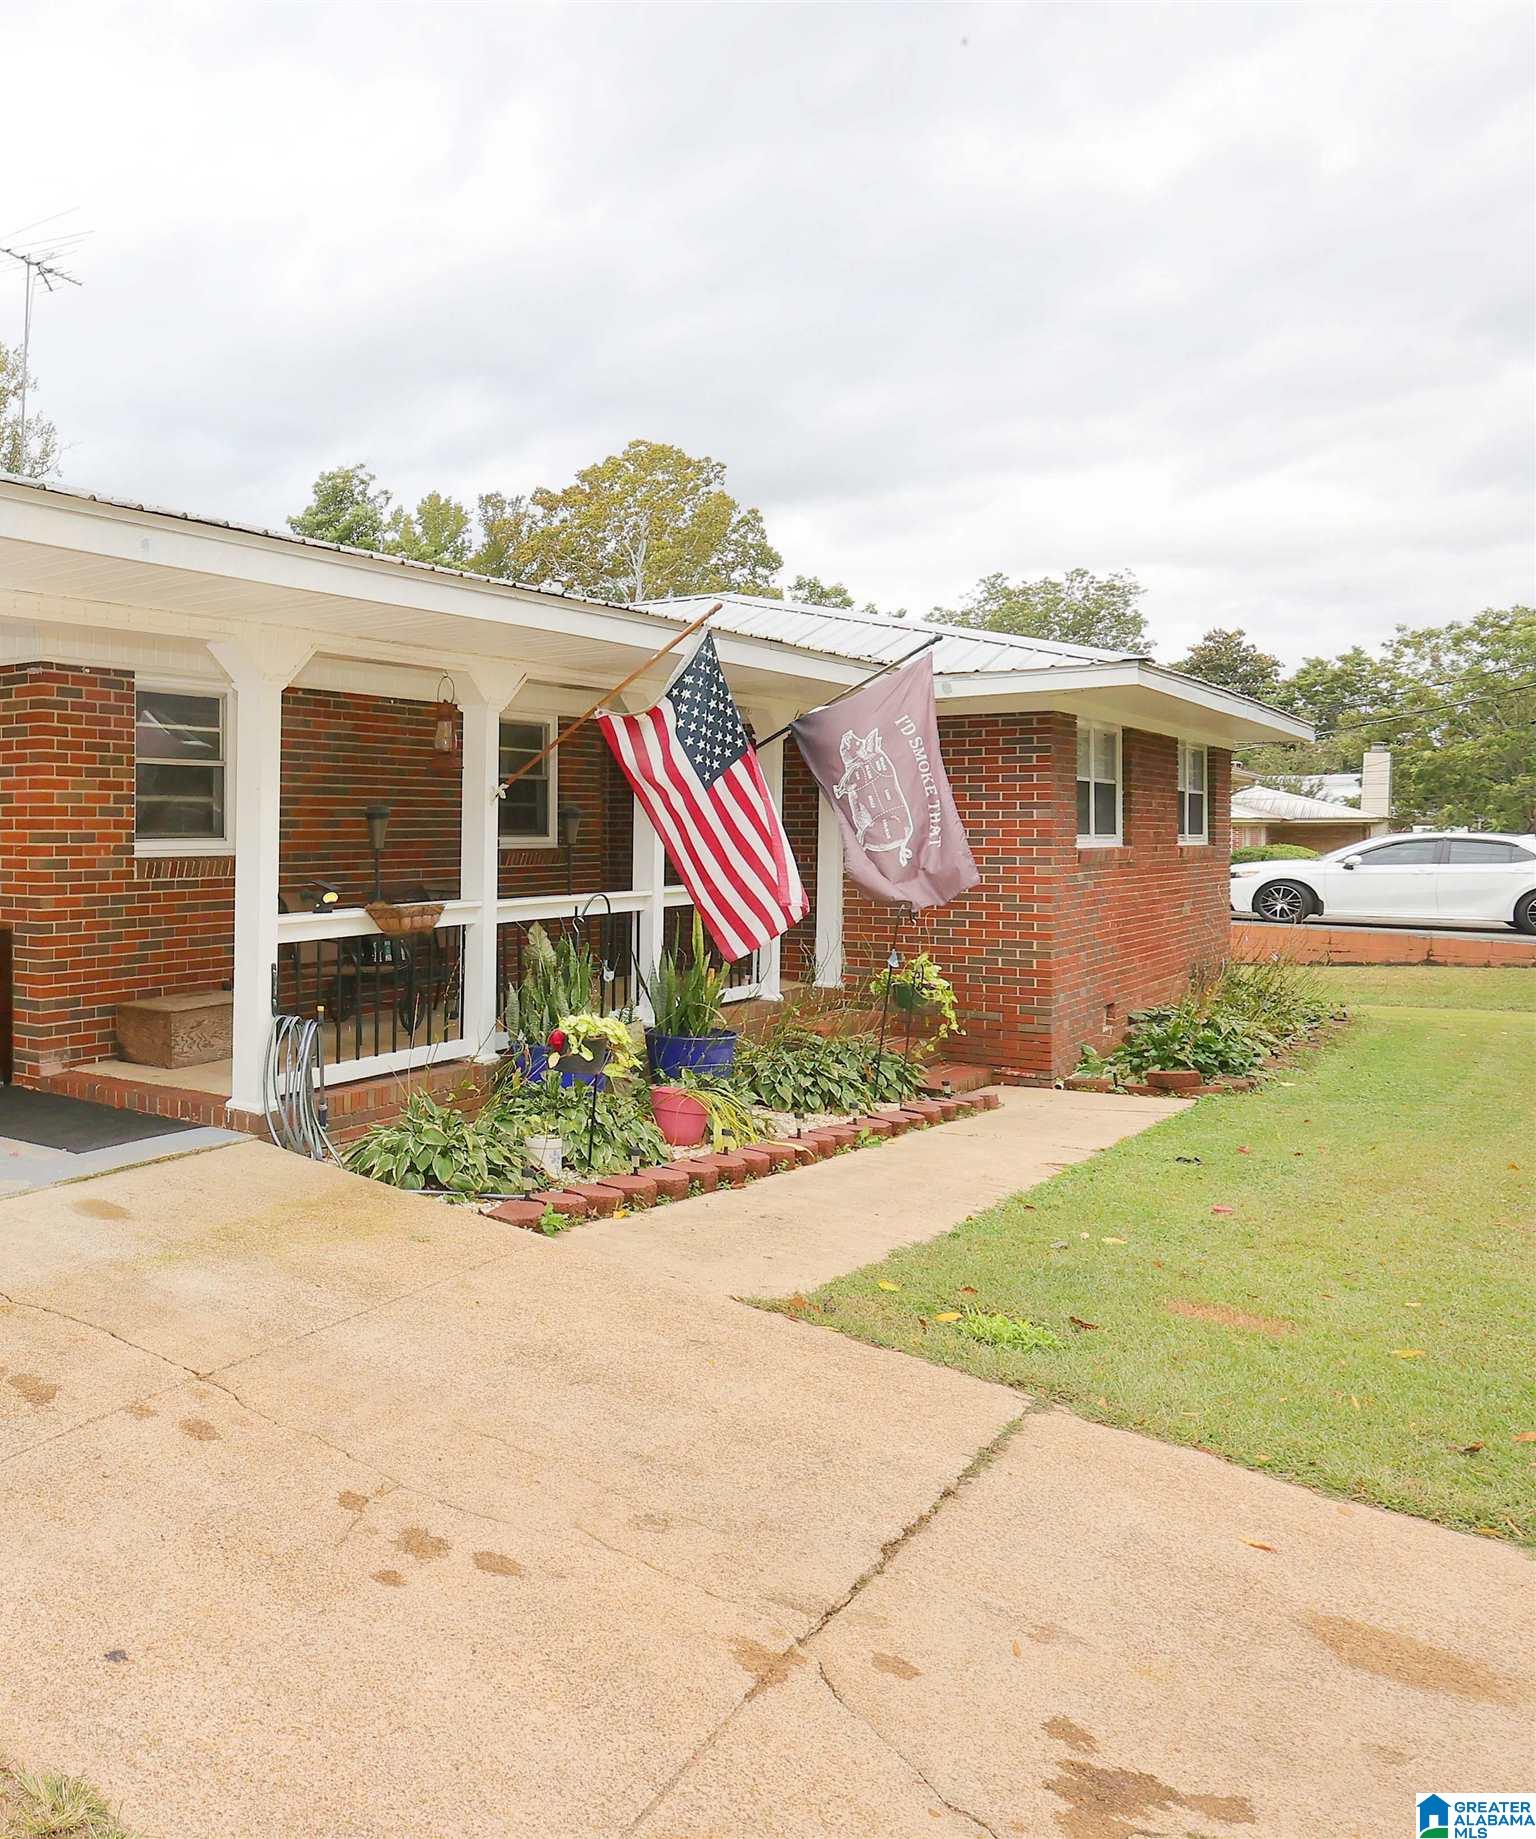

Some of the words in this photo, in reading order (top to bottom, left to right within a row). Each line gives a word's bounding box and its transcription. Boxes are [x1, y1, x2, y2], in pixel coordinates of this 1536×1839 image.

[894, 714, 916, 736] I'D
[909, 736, 938, 797] SMOKE
[927, 799, 942, 848] THAT
